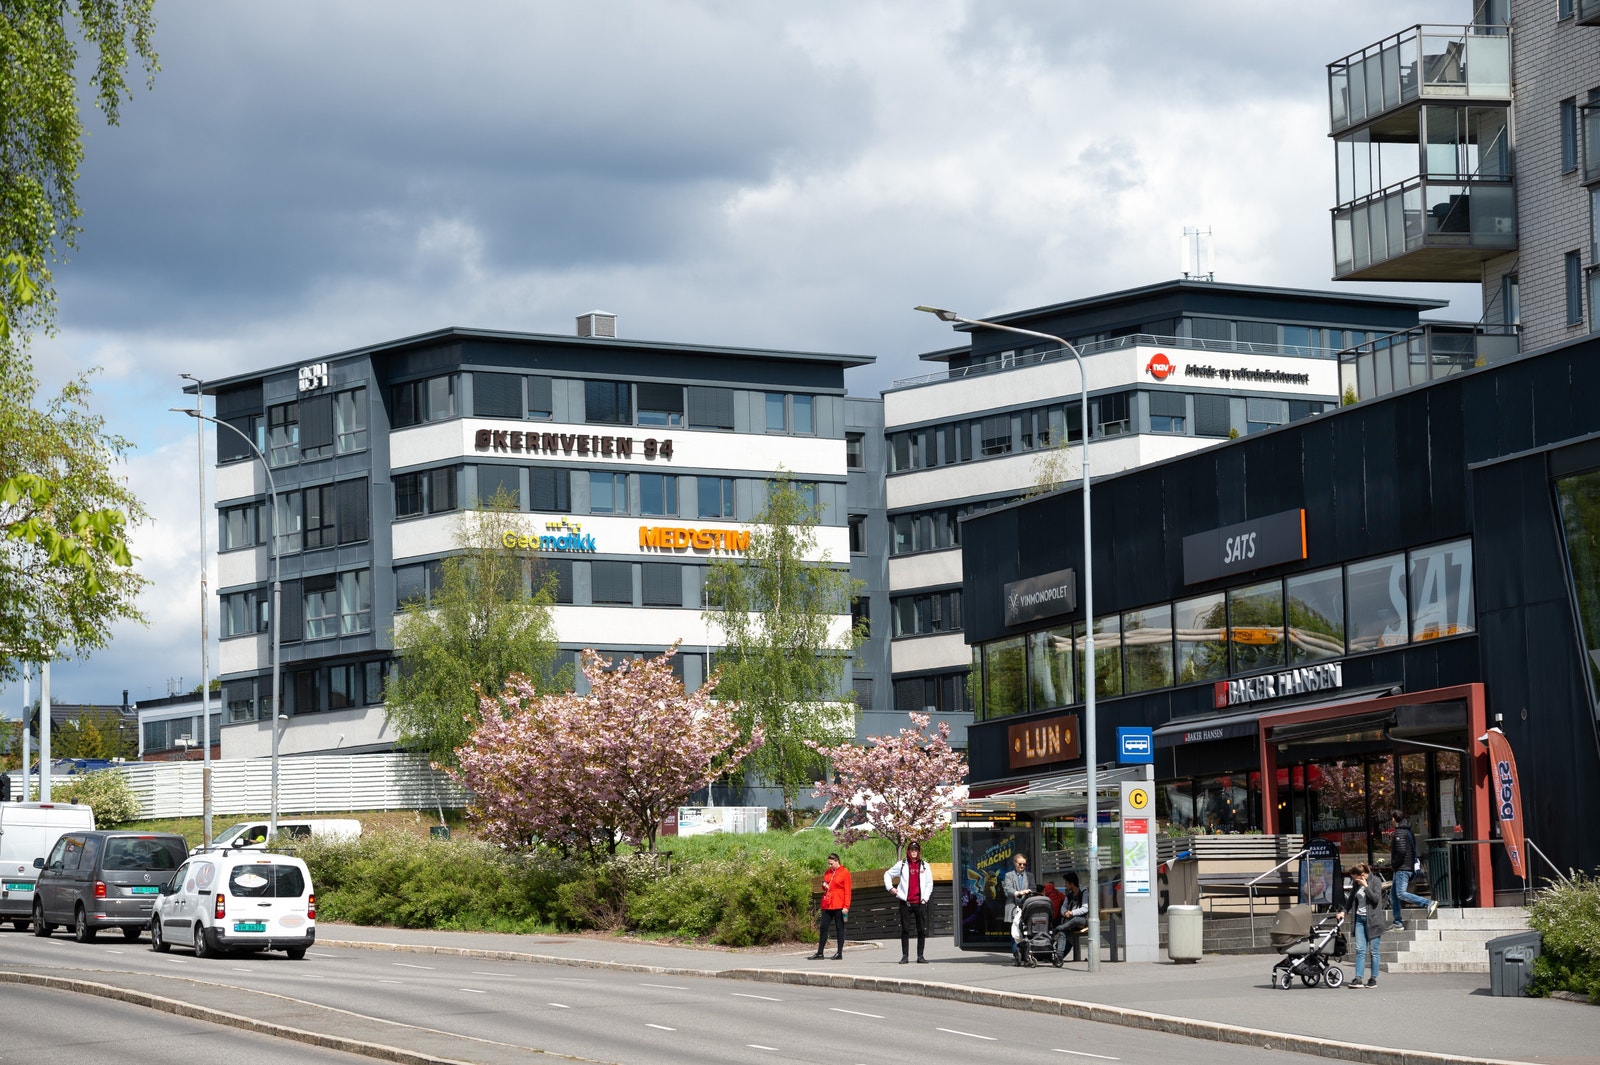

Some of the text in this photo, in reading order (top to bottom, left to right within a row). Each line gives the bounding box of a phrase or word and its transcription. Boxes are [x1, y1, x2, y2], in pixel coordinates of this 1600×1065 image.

[1219, 368, 1231, 379] og
[476, 429, 674, 458] ØKERNVEIEN 94
[502, 529, 597, 551] Geomatikk
[1224, 531, 1257, 564] SATS
[1020, 585, 1068, 607] VINMONOPOLET
[1228, 661, 1343, 705] BAKER HANSEN
[1025, 724, 1061, 759] LUN
[1187, 729, 1223, 742] BAKER HANSEN
[1134, 792, 1143, 805] C
[976, 847, 1012, 870] PIKACHU
